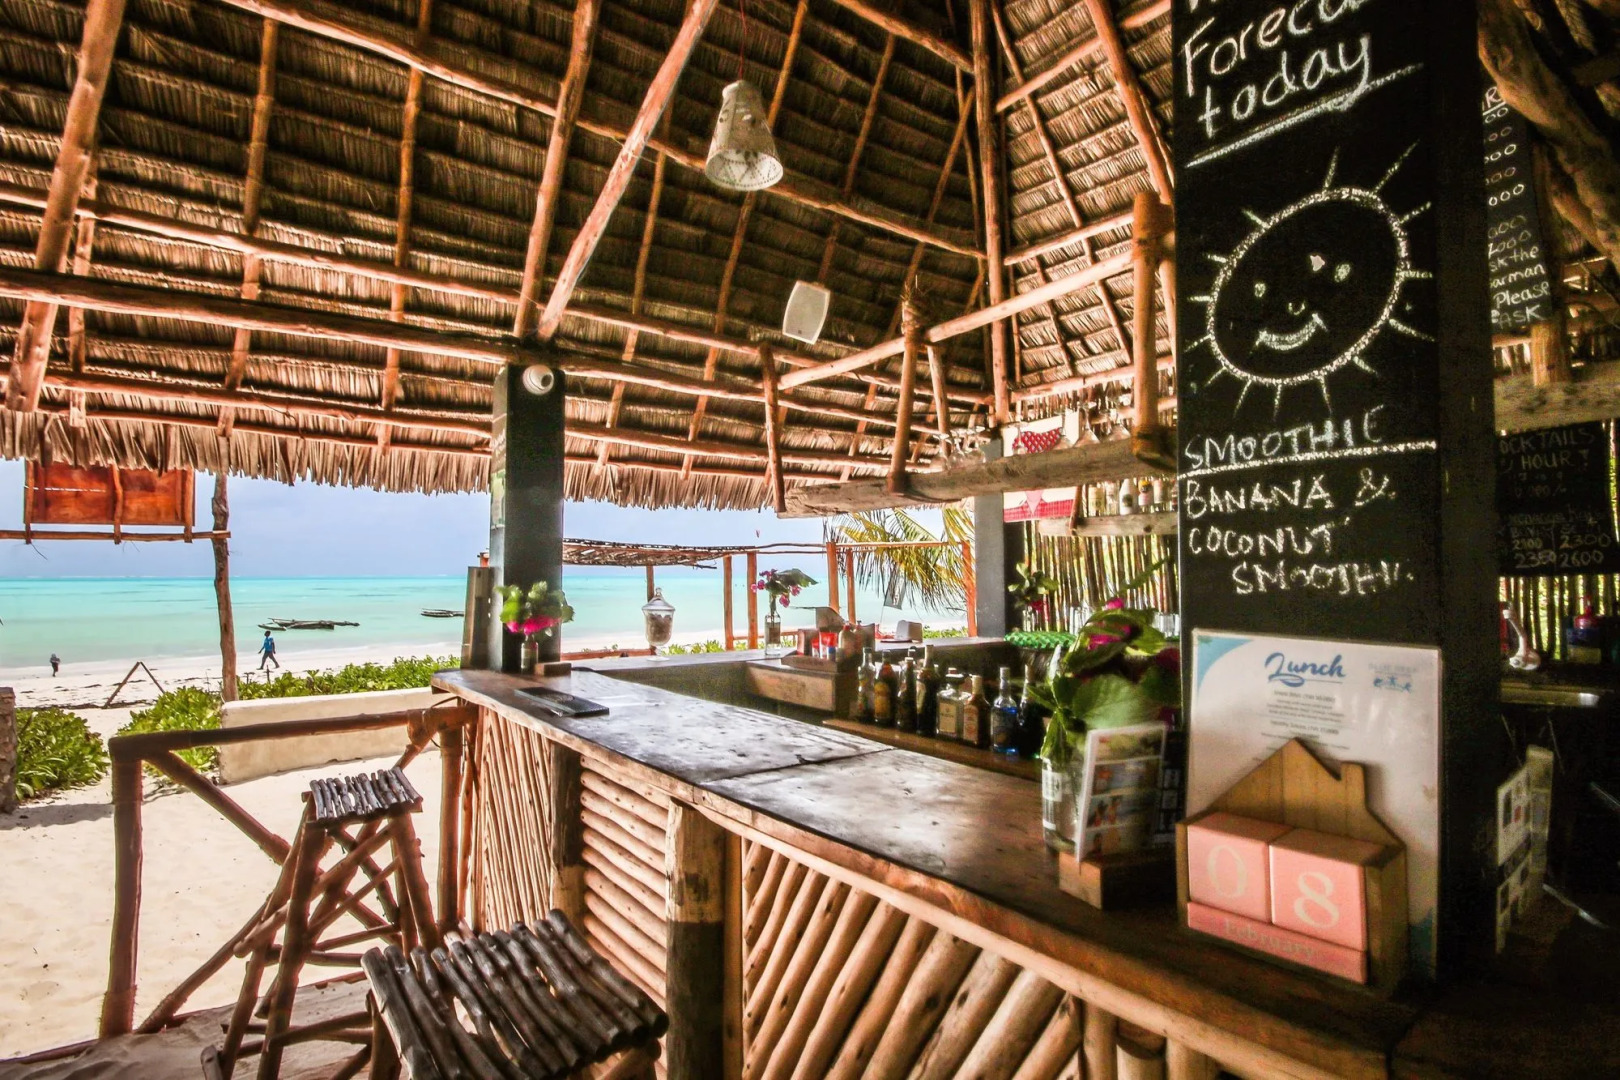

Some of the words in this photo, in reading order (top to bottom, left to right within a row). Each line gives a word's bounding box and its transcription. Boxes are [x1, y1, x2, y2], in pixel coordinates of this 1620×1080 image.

[1198, 34, 1370, 138] today
[1509, 246, 1539, 262] the
[1493, 281, 1550, 309] Please
[1184, 404, 1385, 469] SMOOTHIE
[1500, 428, 1596, 455] OCKTAILS
[1185, 475, 1335, 519] BANANA
[1354, 467, 1391, 507] &
[1189, 517, 1349, 557] COCONUT
[1264, 652, 1346, 688] Lunch
